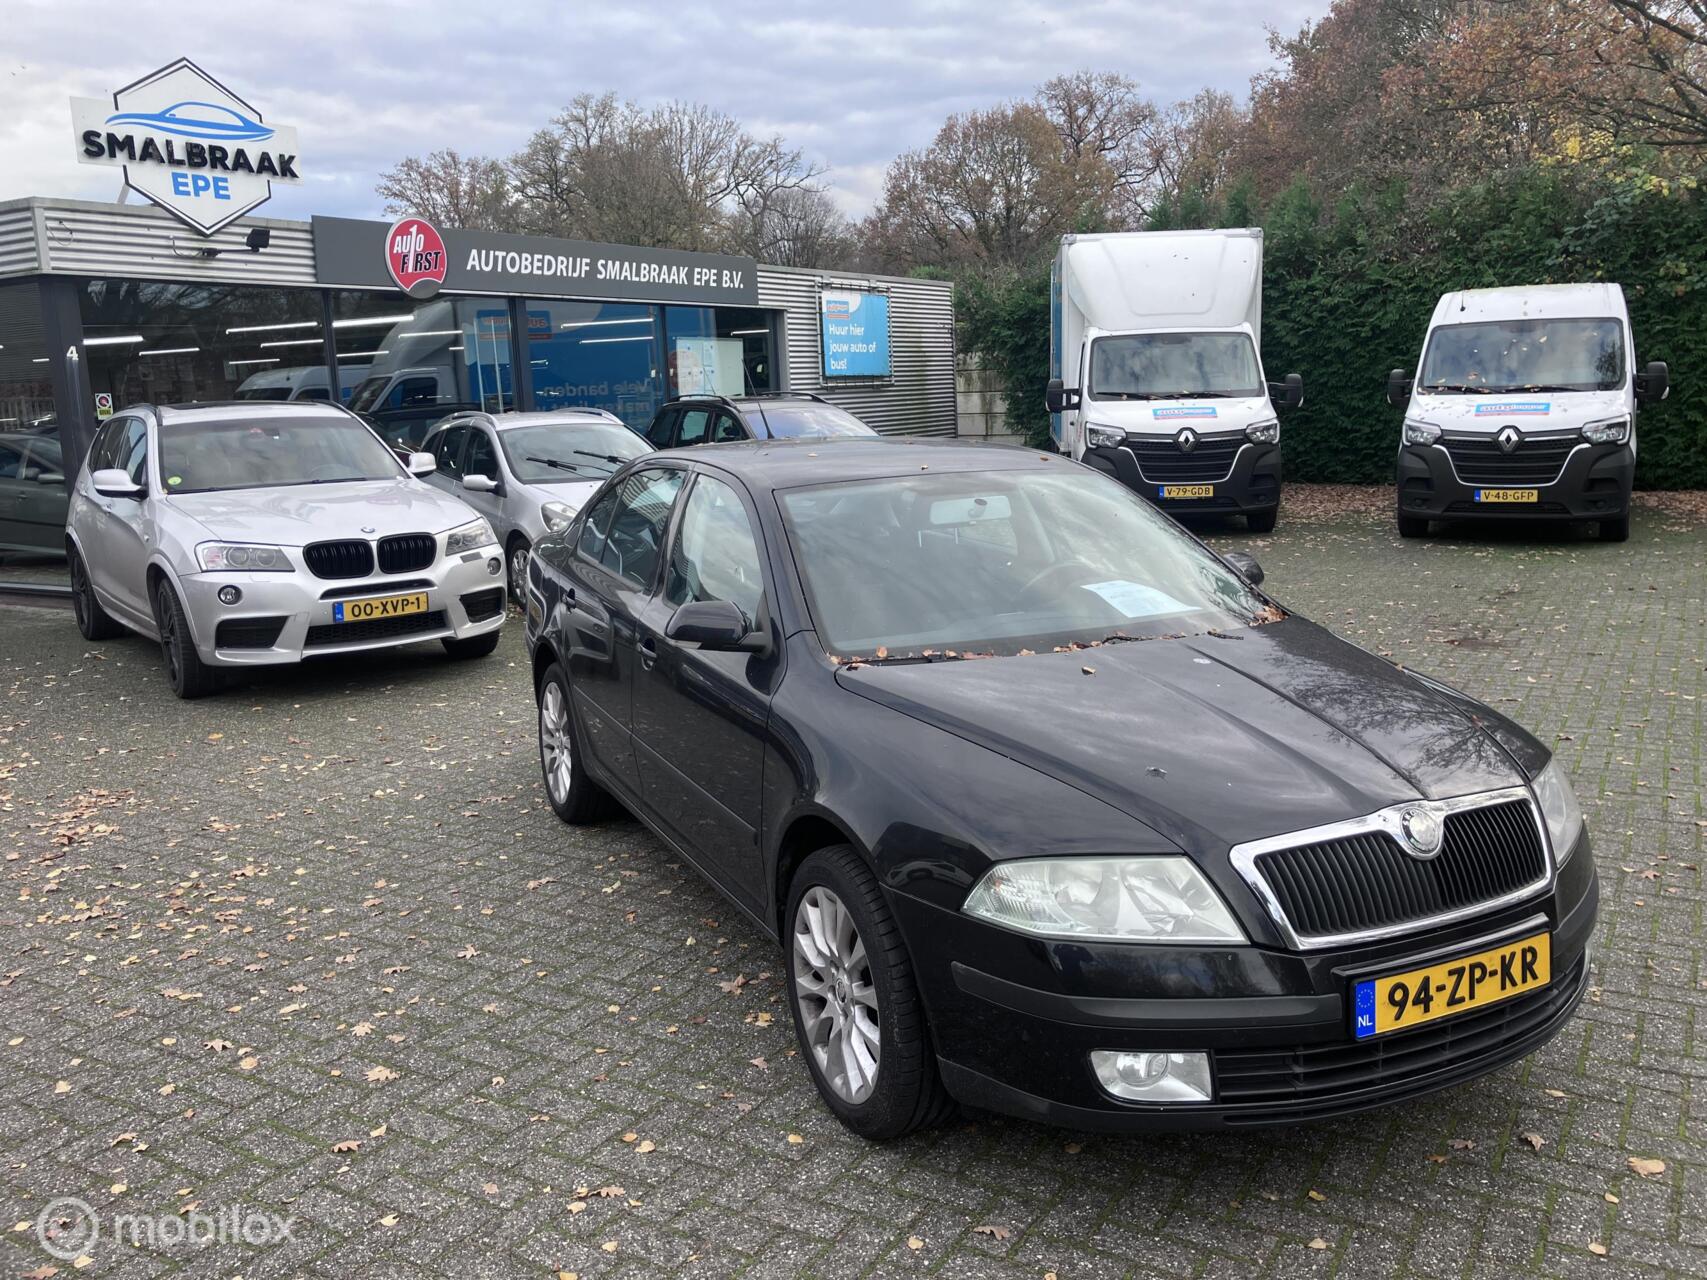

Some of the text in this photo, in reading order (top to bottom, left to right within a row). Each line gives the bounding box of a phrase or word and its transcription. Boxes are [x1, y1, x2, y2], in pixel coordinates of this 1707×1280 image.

[82, 130, 299, 178] SMALBRAAK
[171, 172, 231, 200] EPE
[466, 249, 744, 289] AUTOBEDRIJF SMALBRAAK EPE B.V.
[829, 323, 865, 336] Huur hier
[66, 345, 79, 360] 4
[829, 341, 877, 354] jouw auto of
[831, 359, 848, 370] bus!
[1166, 487, 1210, 496] V-79-GDB
[1483, 491, 1534, 501] V-48-GFP
[351, 596, 420, 618] 00-XVP-1
[1388, 945, 1539, 1021] 94-ZP-KR
[1358, 1014, 1373, 1028] NL
